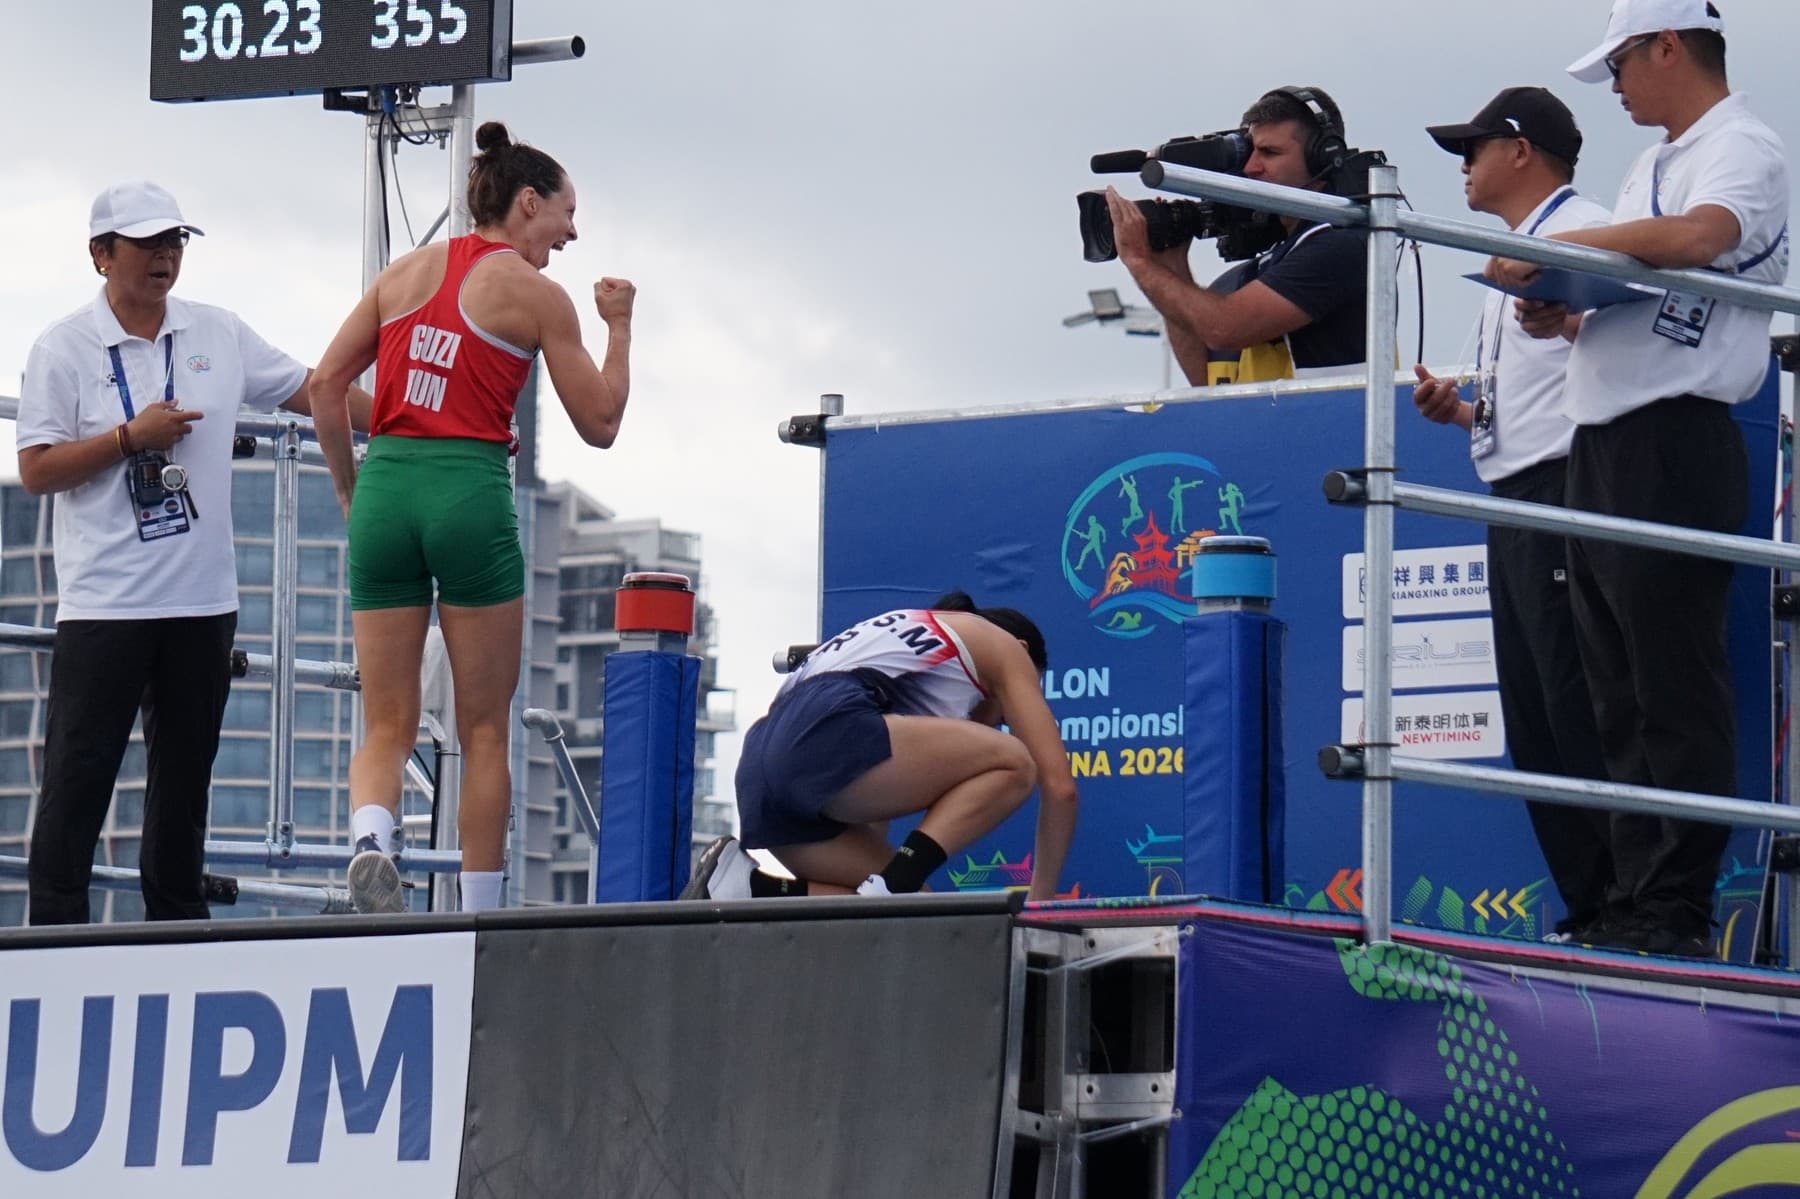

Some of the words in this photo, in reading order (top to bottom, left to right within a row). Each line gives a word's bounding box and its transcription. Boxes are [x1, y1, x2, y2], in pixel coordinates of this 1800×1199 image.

[180, 0, 322, 62] 30.23
[371, 0, 467, 48] 355
[408, 324, 462, 369] GUZI
[1393, 561, 1485, 587] 祥興集團
[1452, 585, 1489, 597] GROUP
[1040, 666, 1110, 700] LON
[1056, 704, 1184, 746] mpions
[1402, 730, 1481, 744] NEWTIMING
[1066, 750, 1112, 778] NA
[3, 983, 434, 1172] UIPM
